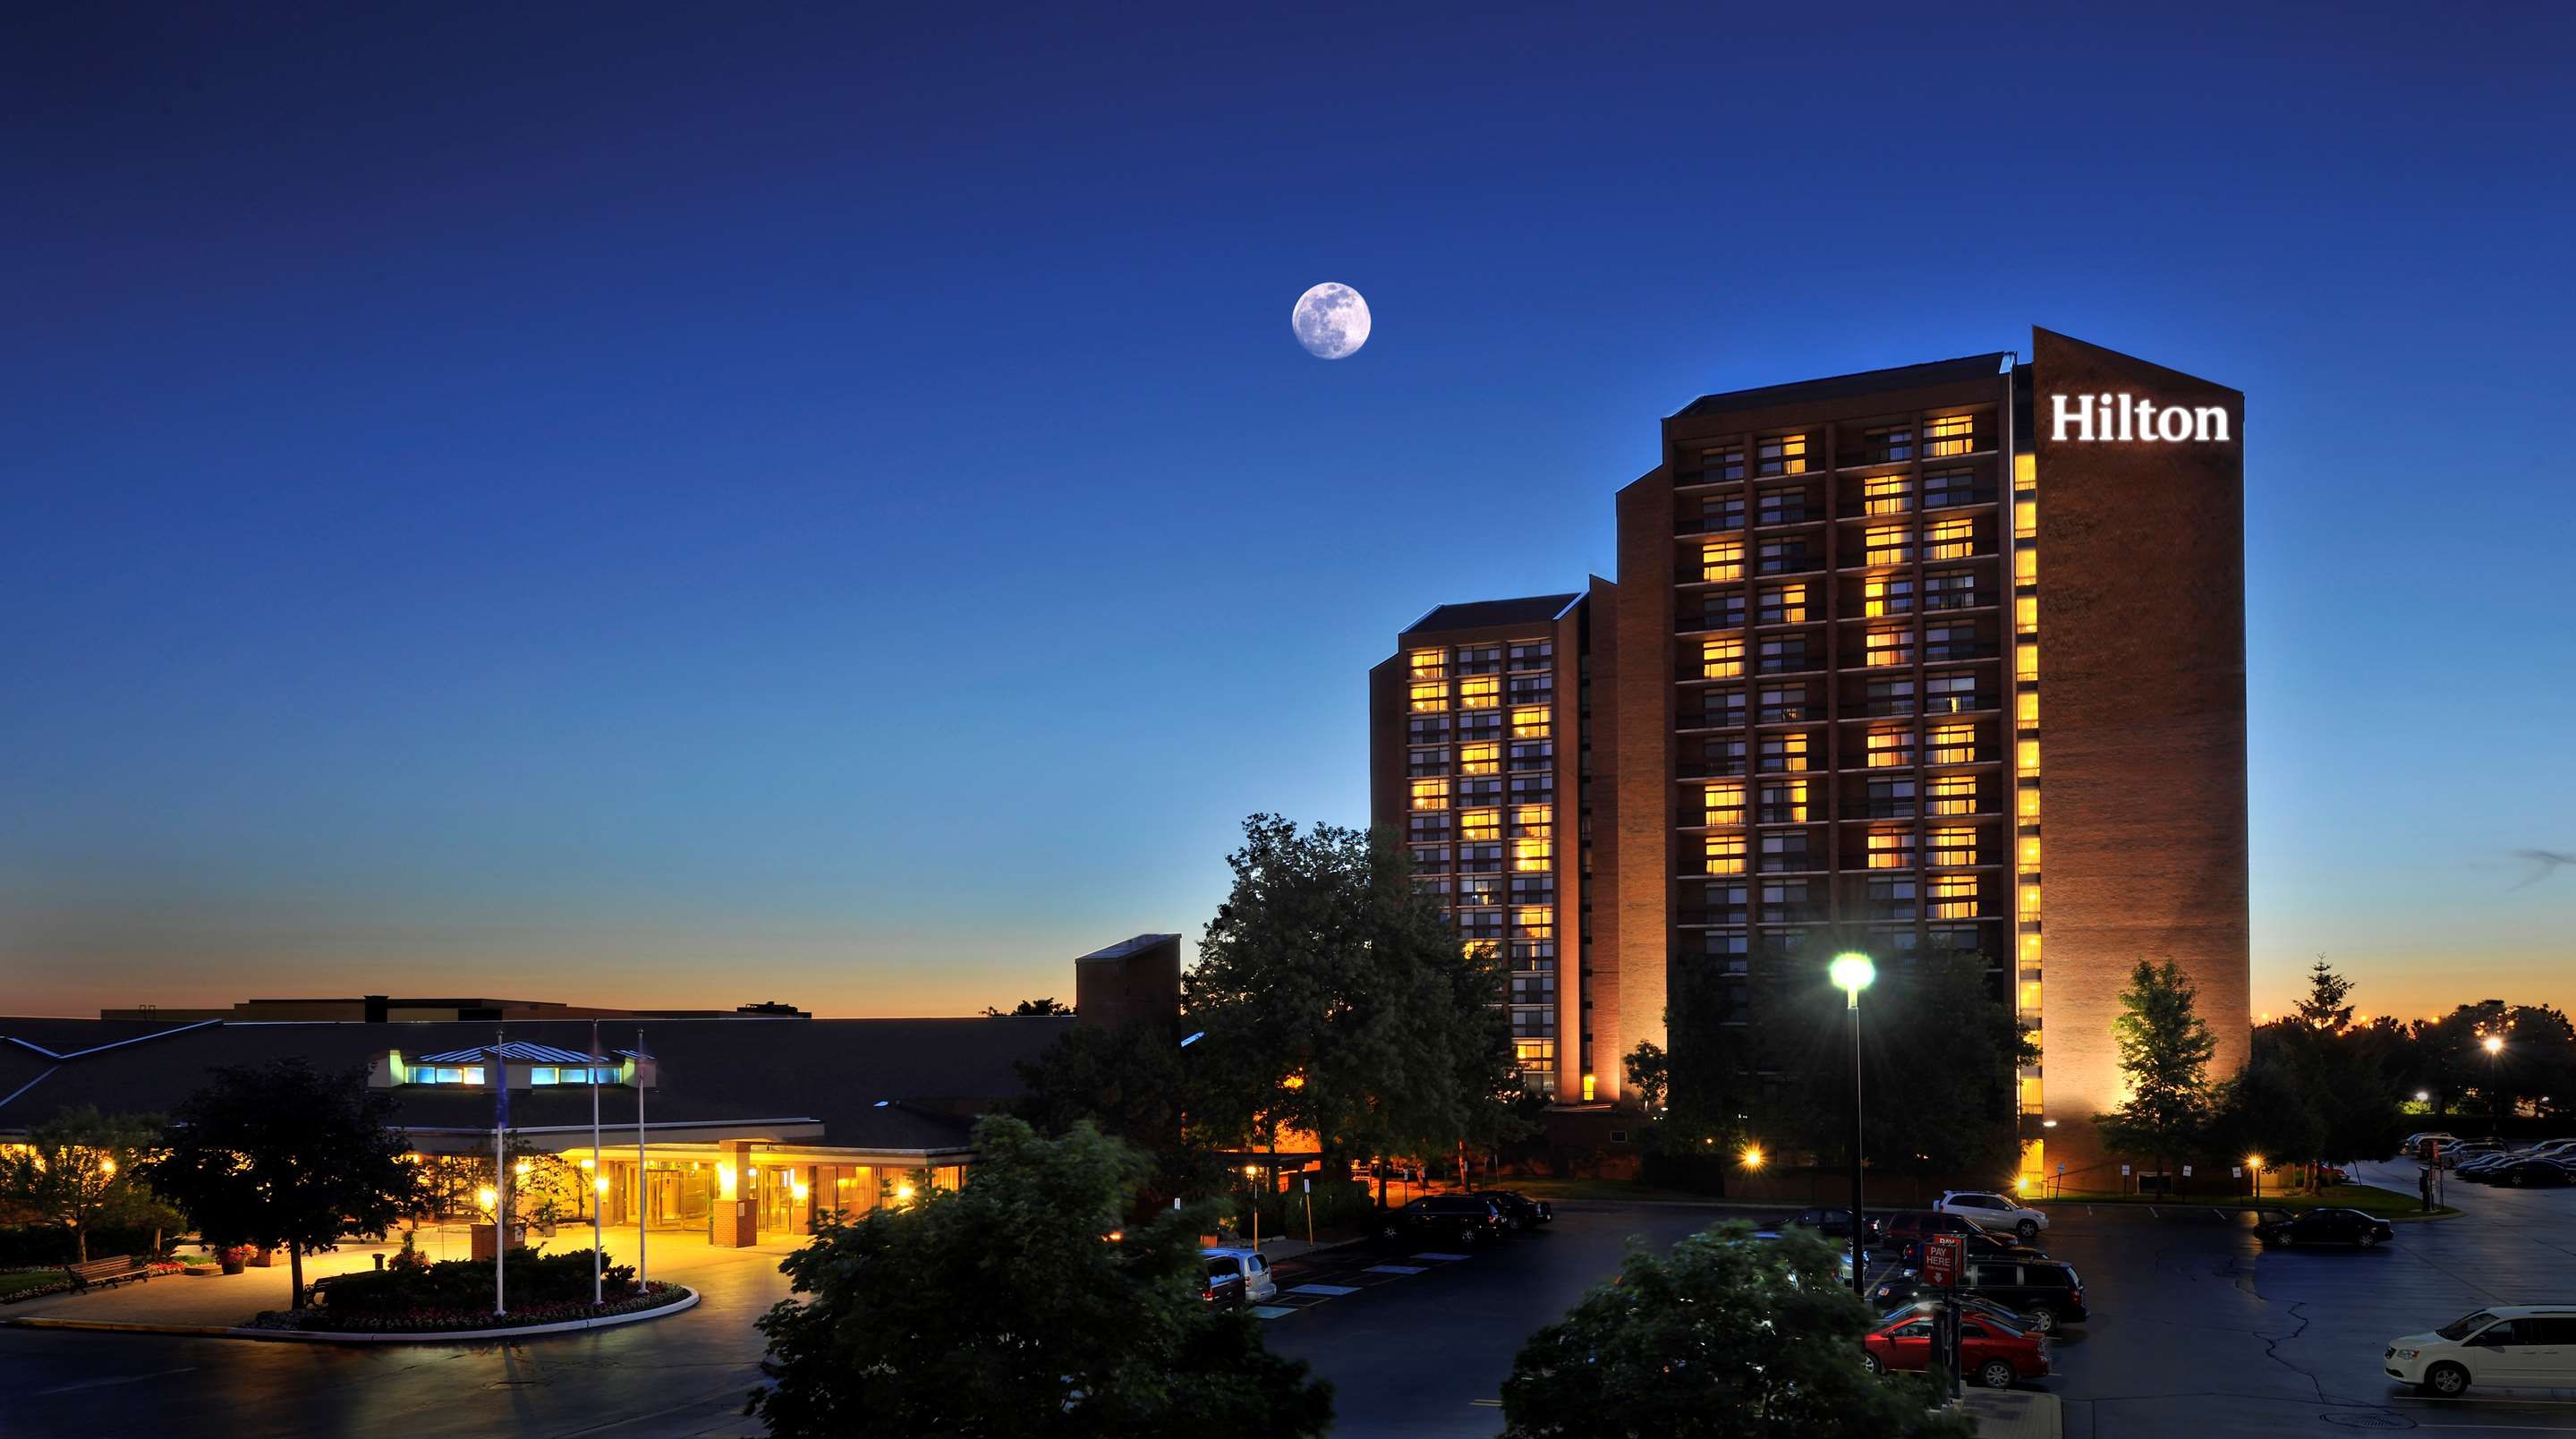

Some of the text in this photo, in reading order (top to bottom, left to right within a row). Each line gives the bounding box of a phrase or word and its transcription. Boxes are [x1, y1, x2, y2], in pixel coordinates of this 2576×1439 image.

[2052, 393, 2230, 441] Hilton
[1931, 1246, 1947, 1256] PAY
[1926, 1255, 1951, 1266] HERE
